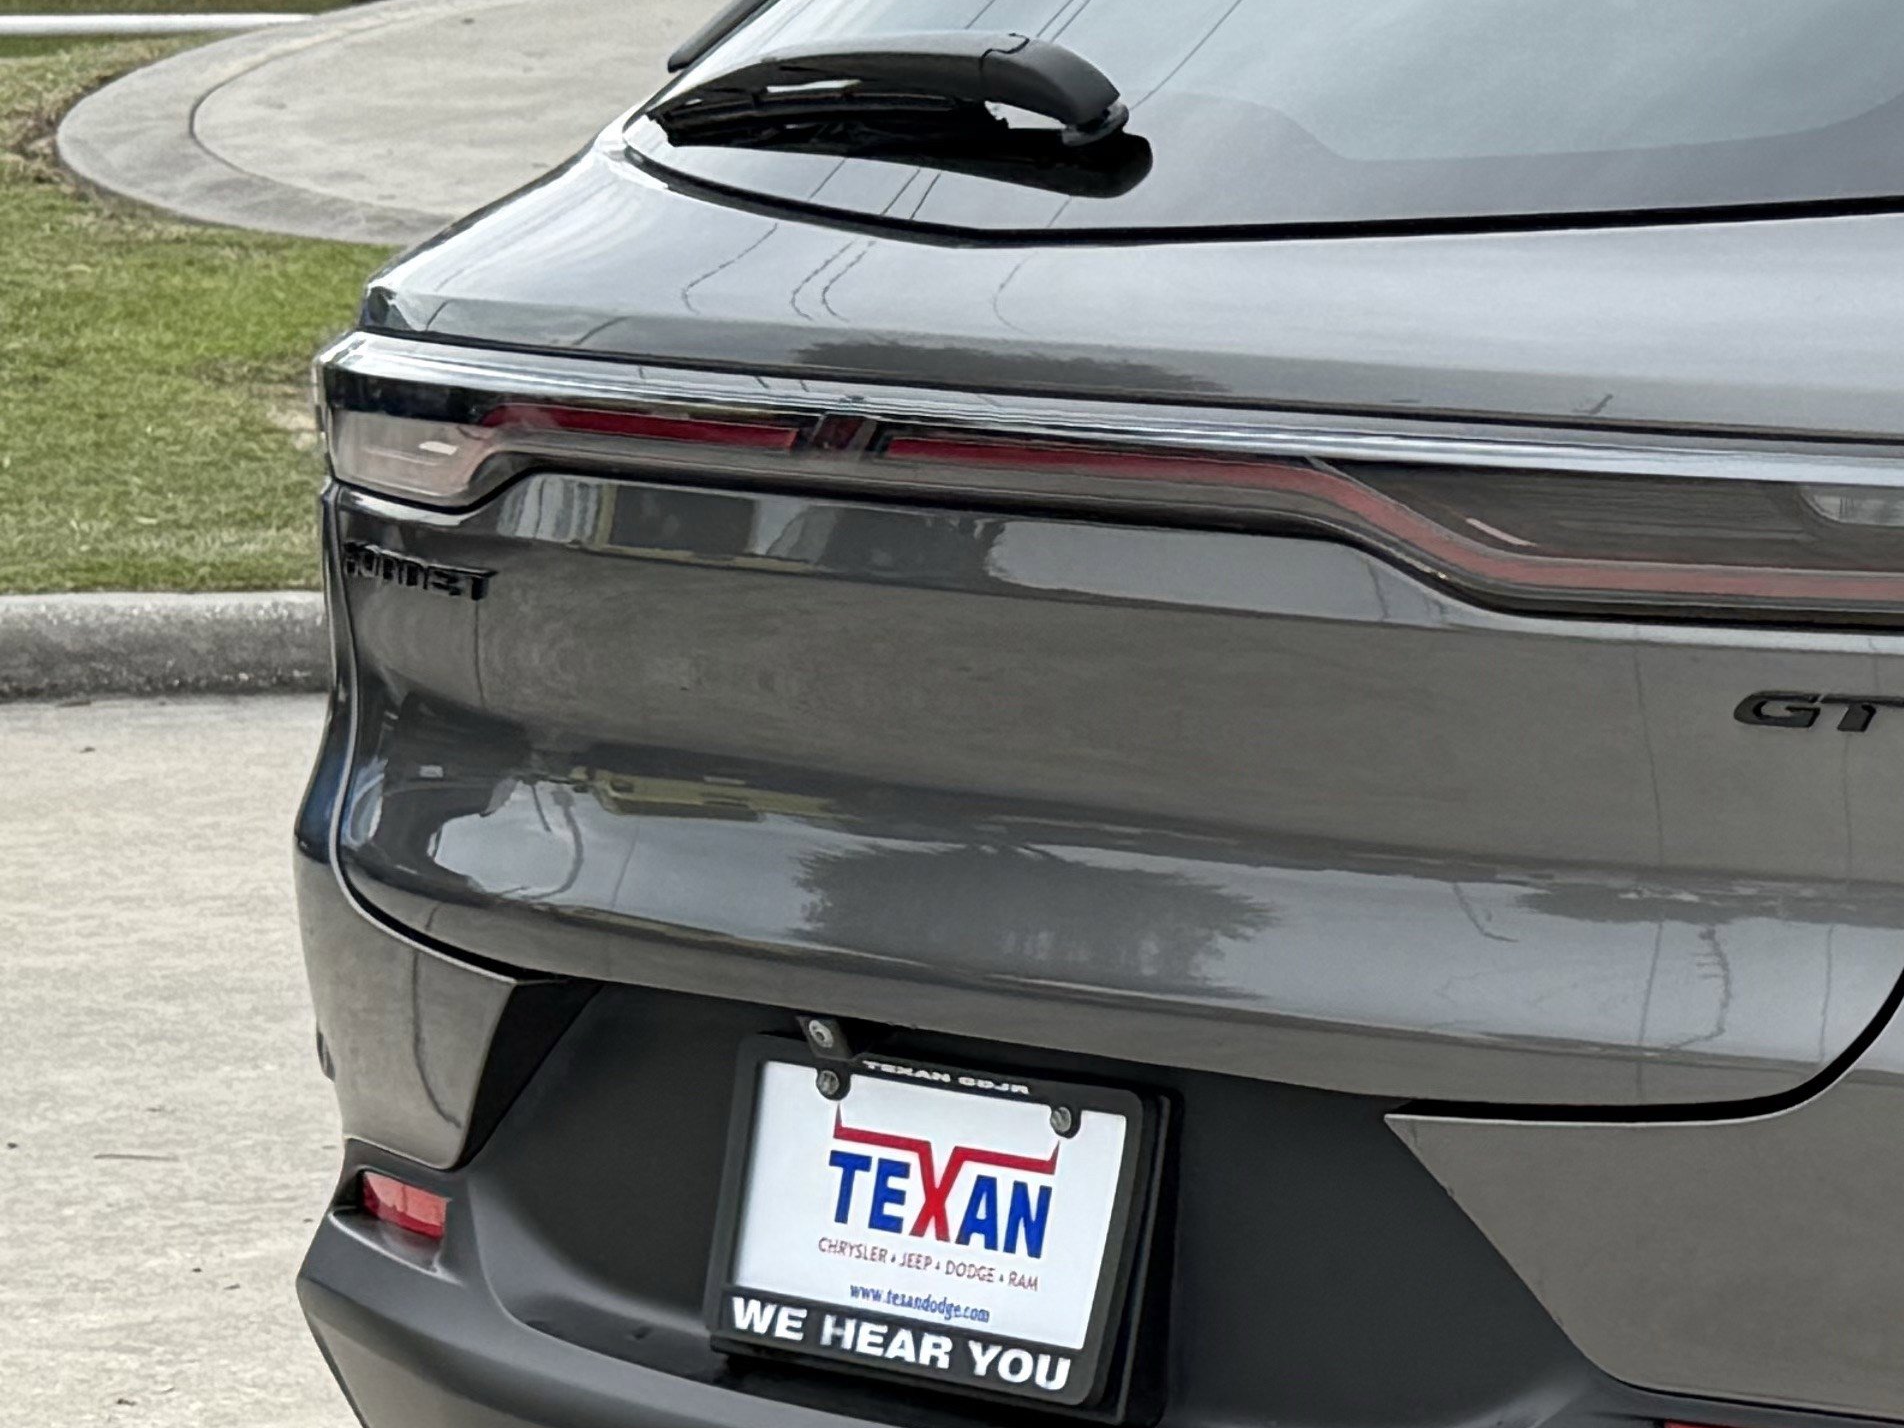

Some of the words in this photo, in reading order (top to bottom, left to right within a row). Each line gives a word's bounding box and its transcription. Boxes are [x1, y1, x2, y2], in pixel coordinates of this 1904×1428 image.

[862, 1059, 950, 1084] TEXAN
[828, 1117, 1058, 1260] TEXAN
[818, 1236, 888, 1265] CHRYSLER
[899, 1249, 933, 1272] JEEP
[945, 1259, 996, 1285] DODGE
[1008, 1269, 1040, 1293] RAM
[849, 1282, 990, 1325] www.texandodge.com
[731, 1295, 808, 1342] WE
[819, 1317, 954, 1371] HEAR
[967, 1338, 1072, 1392] YOU
